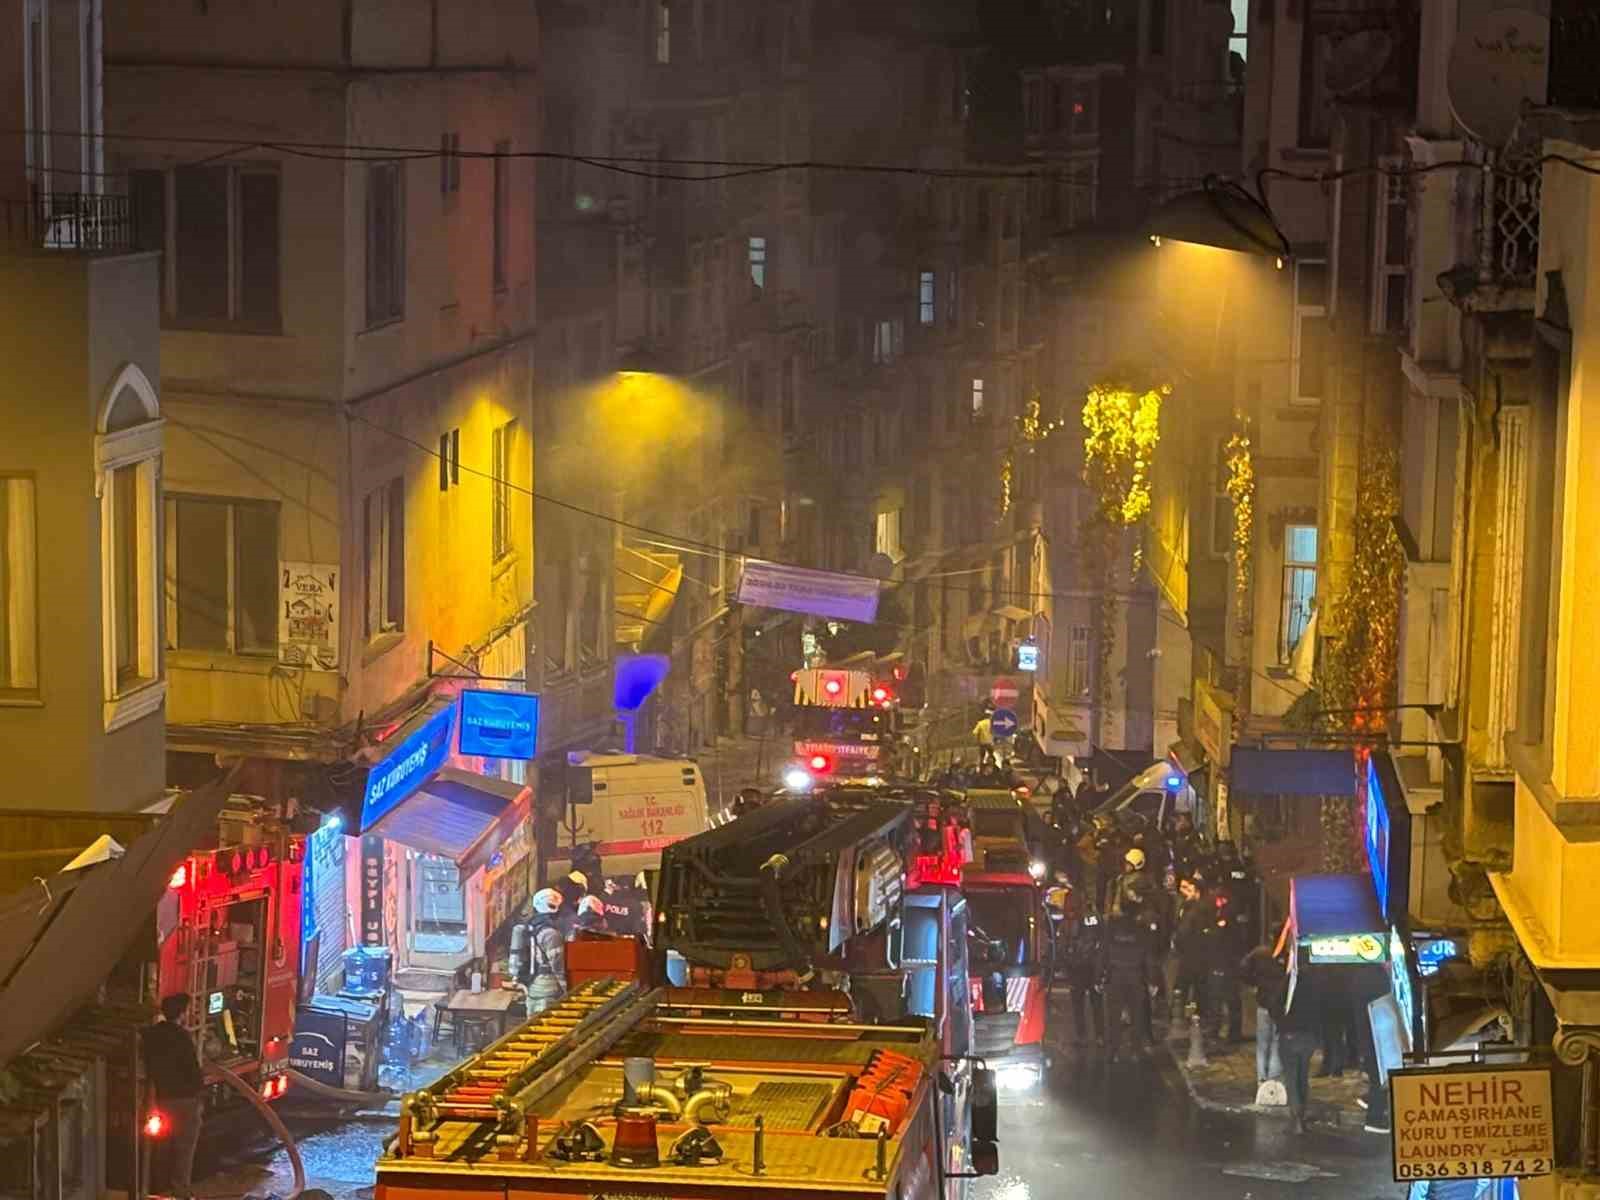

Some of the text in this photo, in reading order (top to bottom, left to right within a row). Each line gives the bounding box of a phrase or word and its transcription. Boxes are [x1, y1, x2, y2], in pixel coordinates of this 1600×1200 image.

[369, 775, 386, 805] SAZ
[641, 819, 664, 836] 112
[302, 1047, 319, 1056] SAZ
[1420, 1076, 1524, 1106] NEHİR
[1404, 1105, 1542, 1125] ÇAMAŞIRHANE
[1401, 1122, 1548, 1141] KURU TEMİZLEME
[1400, 1143, 1486, 1159] LAUNDRY
[1400, 1162, 1449, 1177] 0536
[1456, 1161, 1493, 1176] 318
[1502, 1160, 1525, 1173] 74
